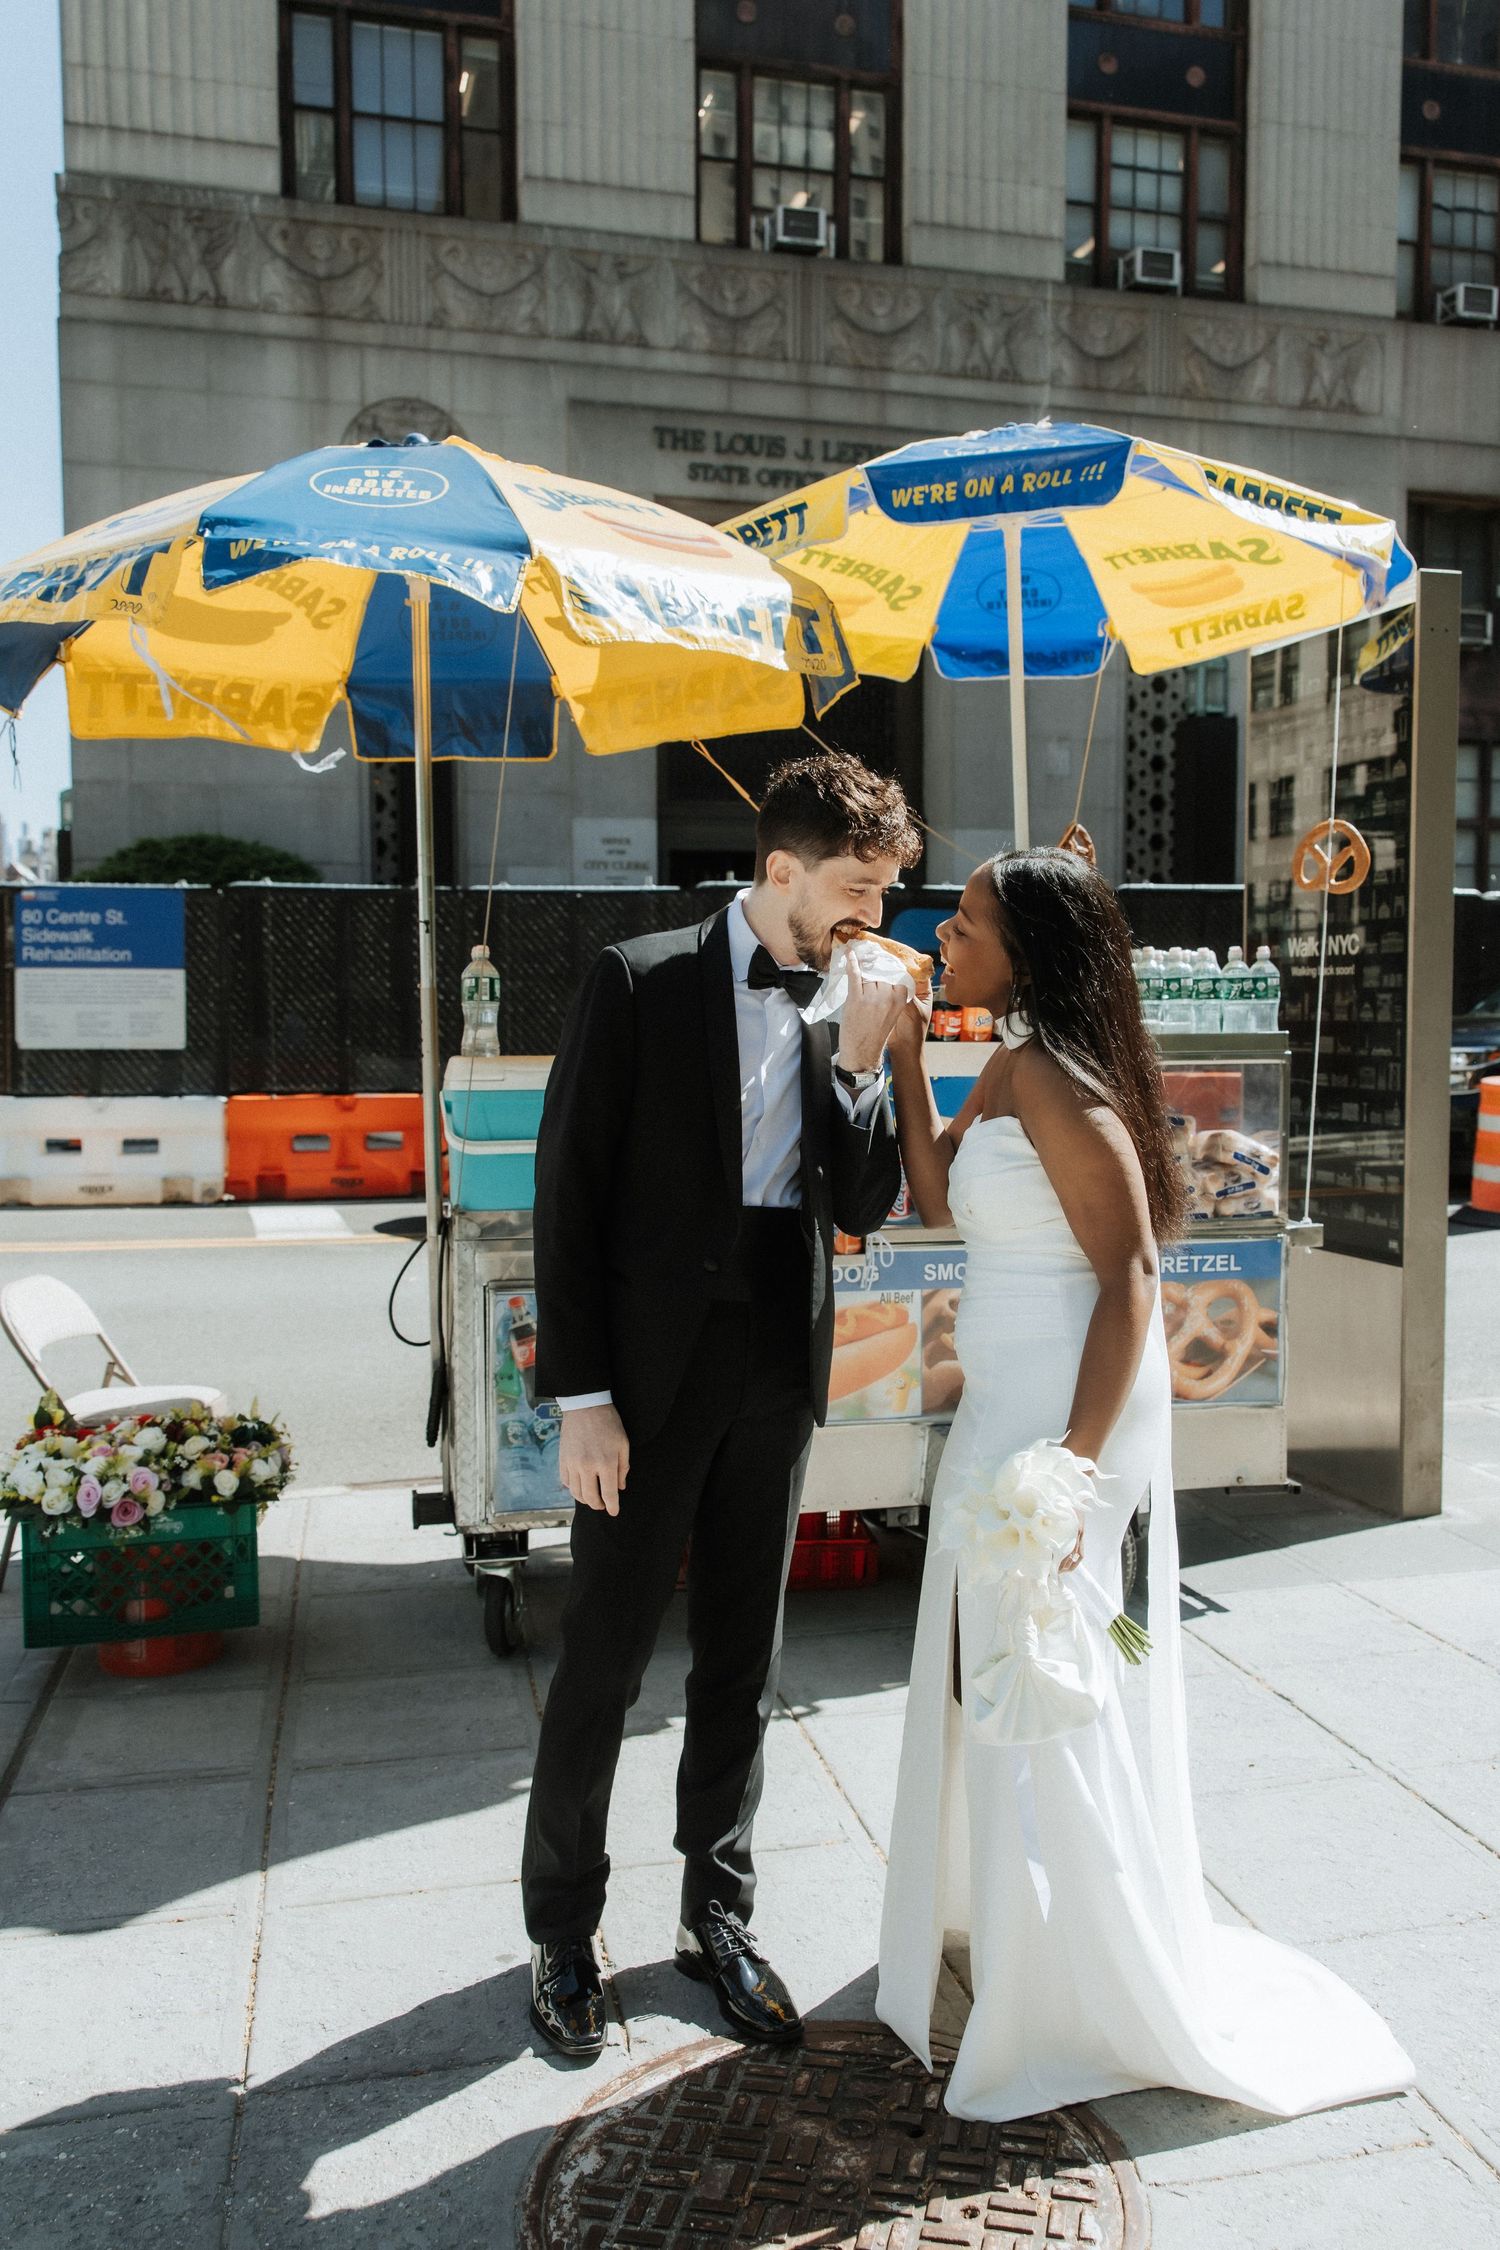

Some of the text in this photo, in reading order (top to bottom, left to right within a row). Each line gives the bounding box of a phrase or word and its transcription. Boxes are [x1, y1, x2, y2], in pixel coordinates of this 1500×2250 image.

[653, 426, 705, 454] THE
[715, 430, 786, 459] LOUIS
[687, 462, 749, 487] STATE
[891, 460, 1107, 508] WE'RE ON A ROLL !!!
[725, 502, 810, 548] RETT
[388, 546, 452, 565] ROLL
[45, 908, 101, 925] Centre
[22, 926, 94, 944] Sidewalk
[22, 945, 133, 962] Rehabilitation
[1288, 932, 1360, 958] Walk NYC
[1291, 966, 1317, 979] Walking
[1161, 1254, 1242, 1273] RETZEL
[894, 1291, 914, 1304] Beef
